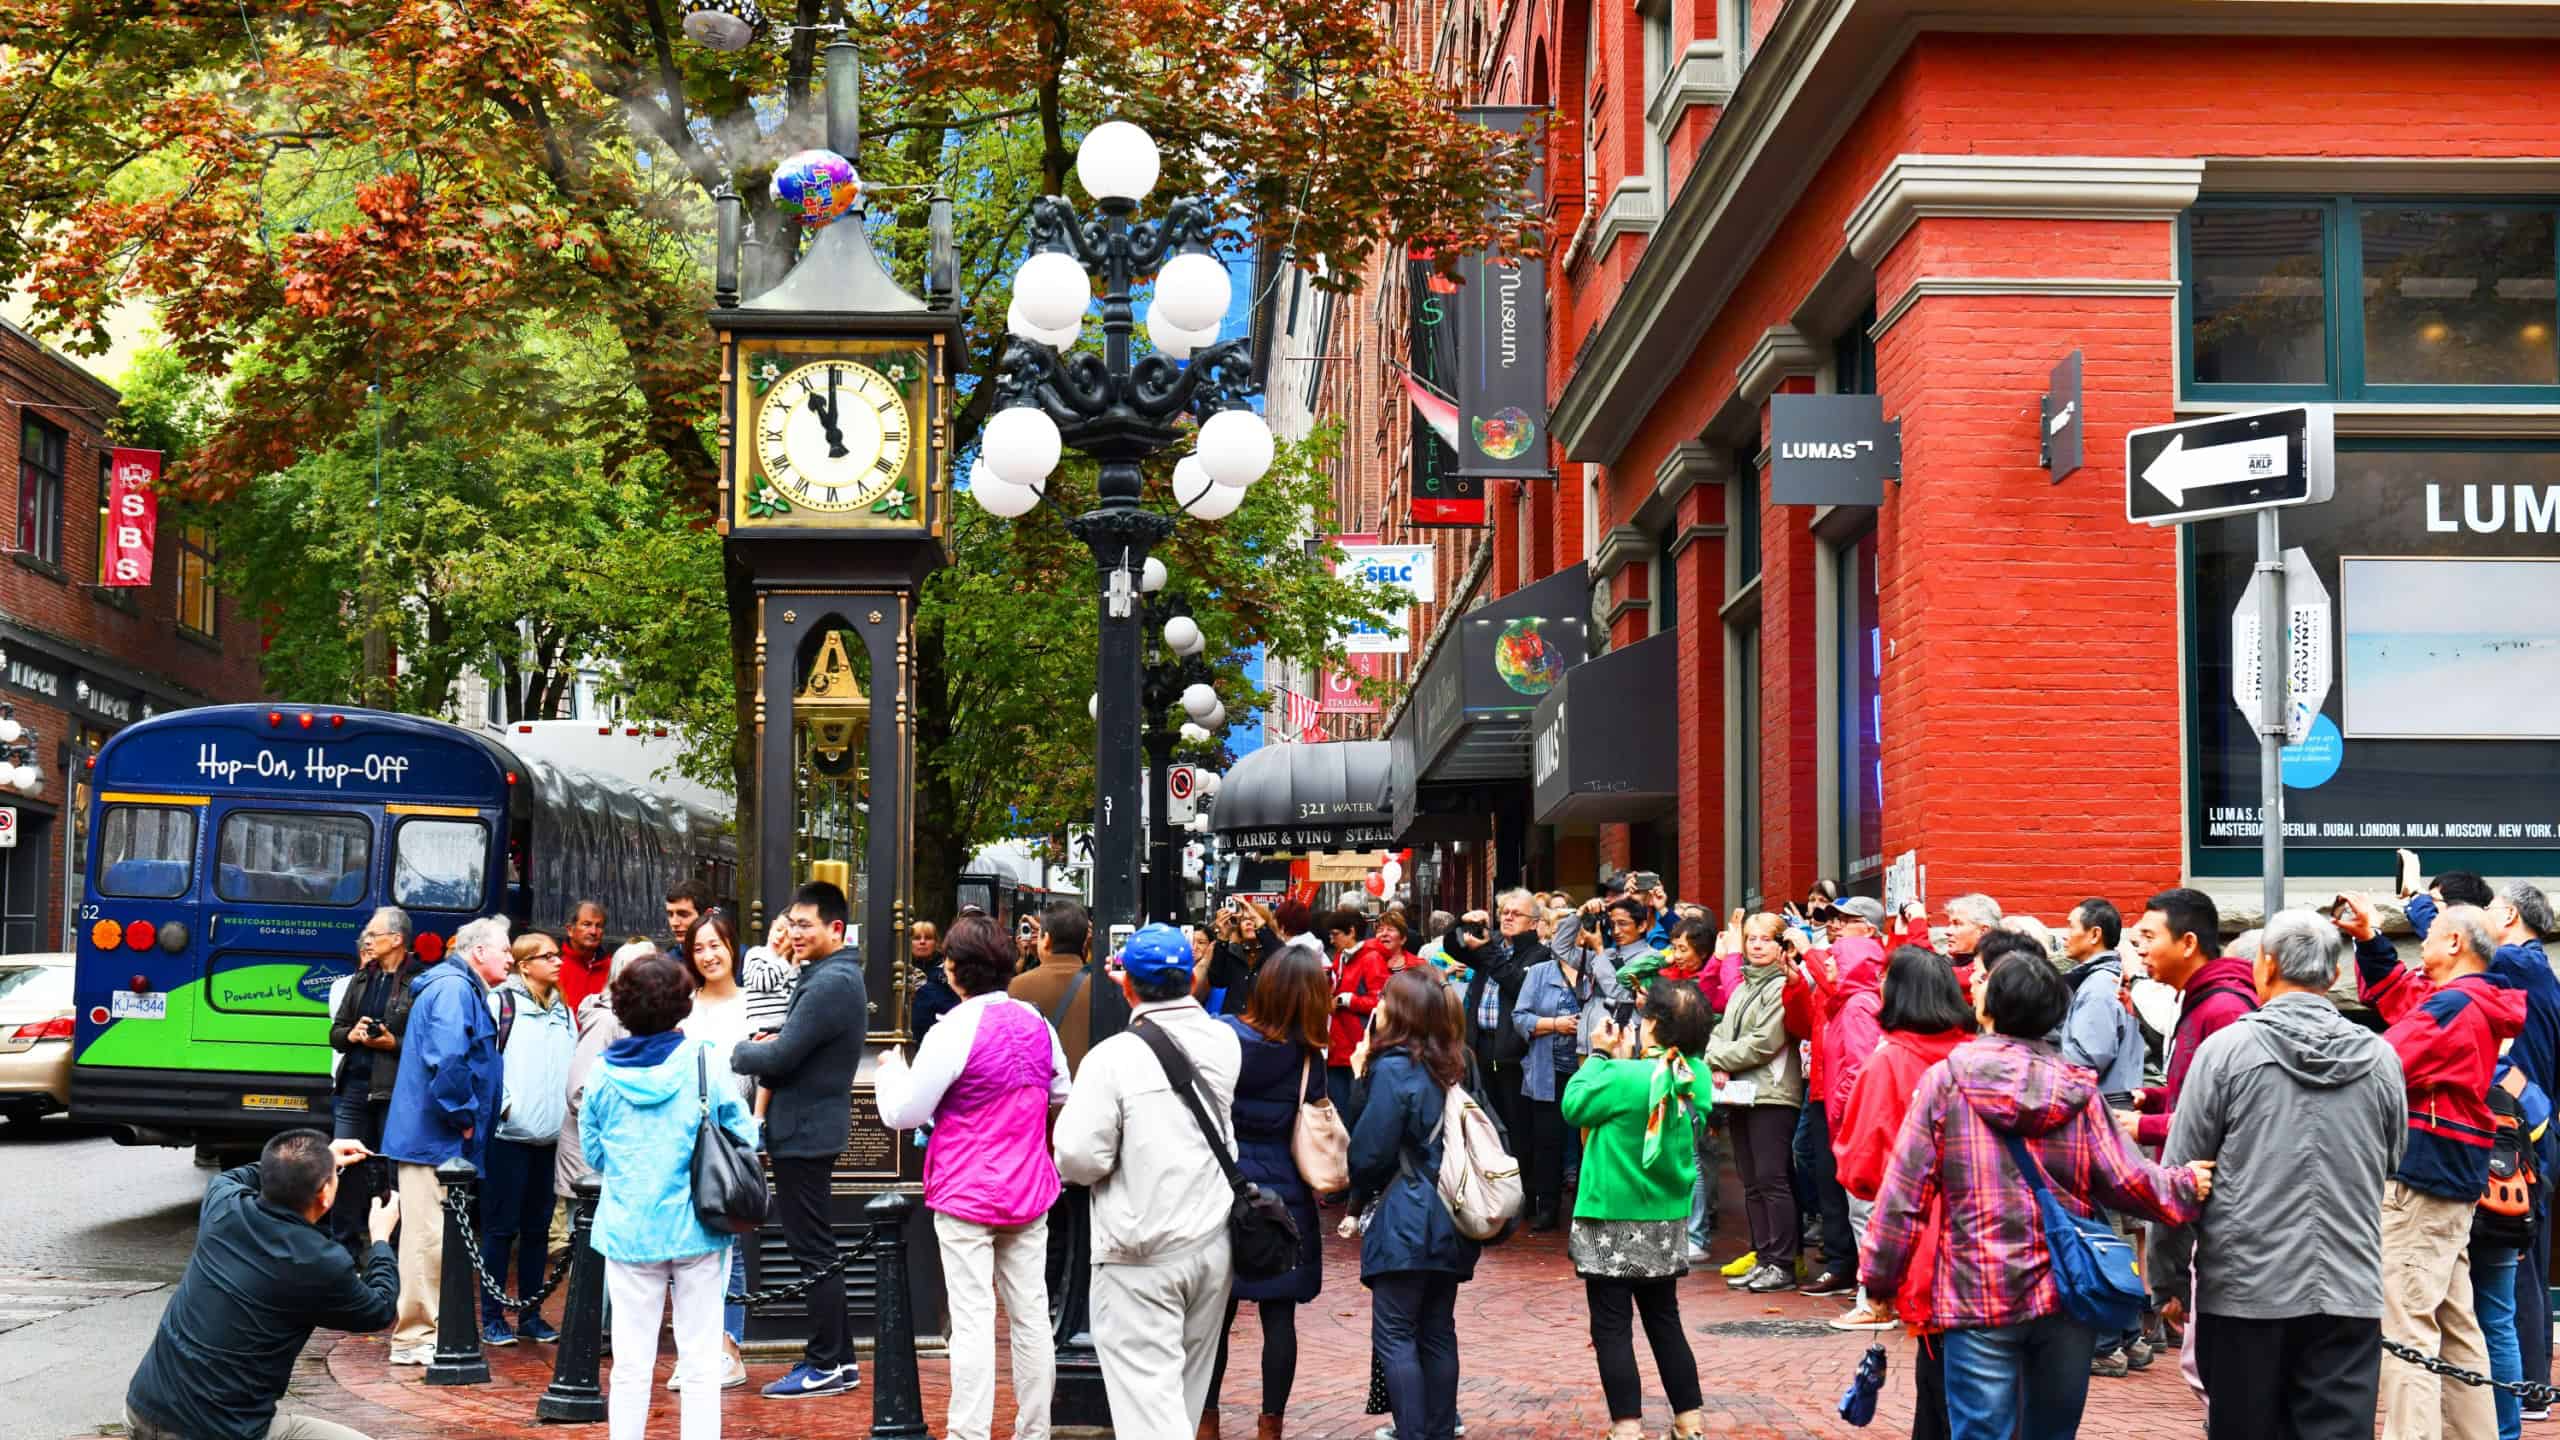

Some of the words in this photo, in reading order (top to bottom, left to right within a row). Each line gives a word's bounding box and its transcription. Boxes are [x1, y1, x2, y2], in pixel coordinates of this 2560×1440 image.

[1782, 443, 1856, 459] LUMAS
[2425, 483, 2560, 533] LUM
[115, 494, 145, 581] SBS
[1366, 565, 1412, 583] SELC
[2301, 610, 2309, 693] MOVING
[1535, 719, 1560, 788] LUMAS
[197, 743, 296, 784] Hop-On,
[304, 747, 409, 788] Hop-Off
[1299, 803, 1326, 819] 321
[1331, 802, 1375, 813] WATER
[1236, 831, 1277, 849] CARNE
[1281, 831, 1293, 845] &
[1296, 830, 1332, 845] VINO
[2210, 823, 2264, 837] AMSTERDA
[2498, 823, 2522, 837] NEW
[2525, 823, 2552, 837] YORK
[223, 984, 273, 1003] Powered
[276, 983, 293, 1001] by
